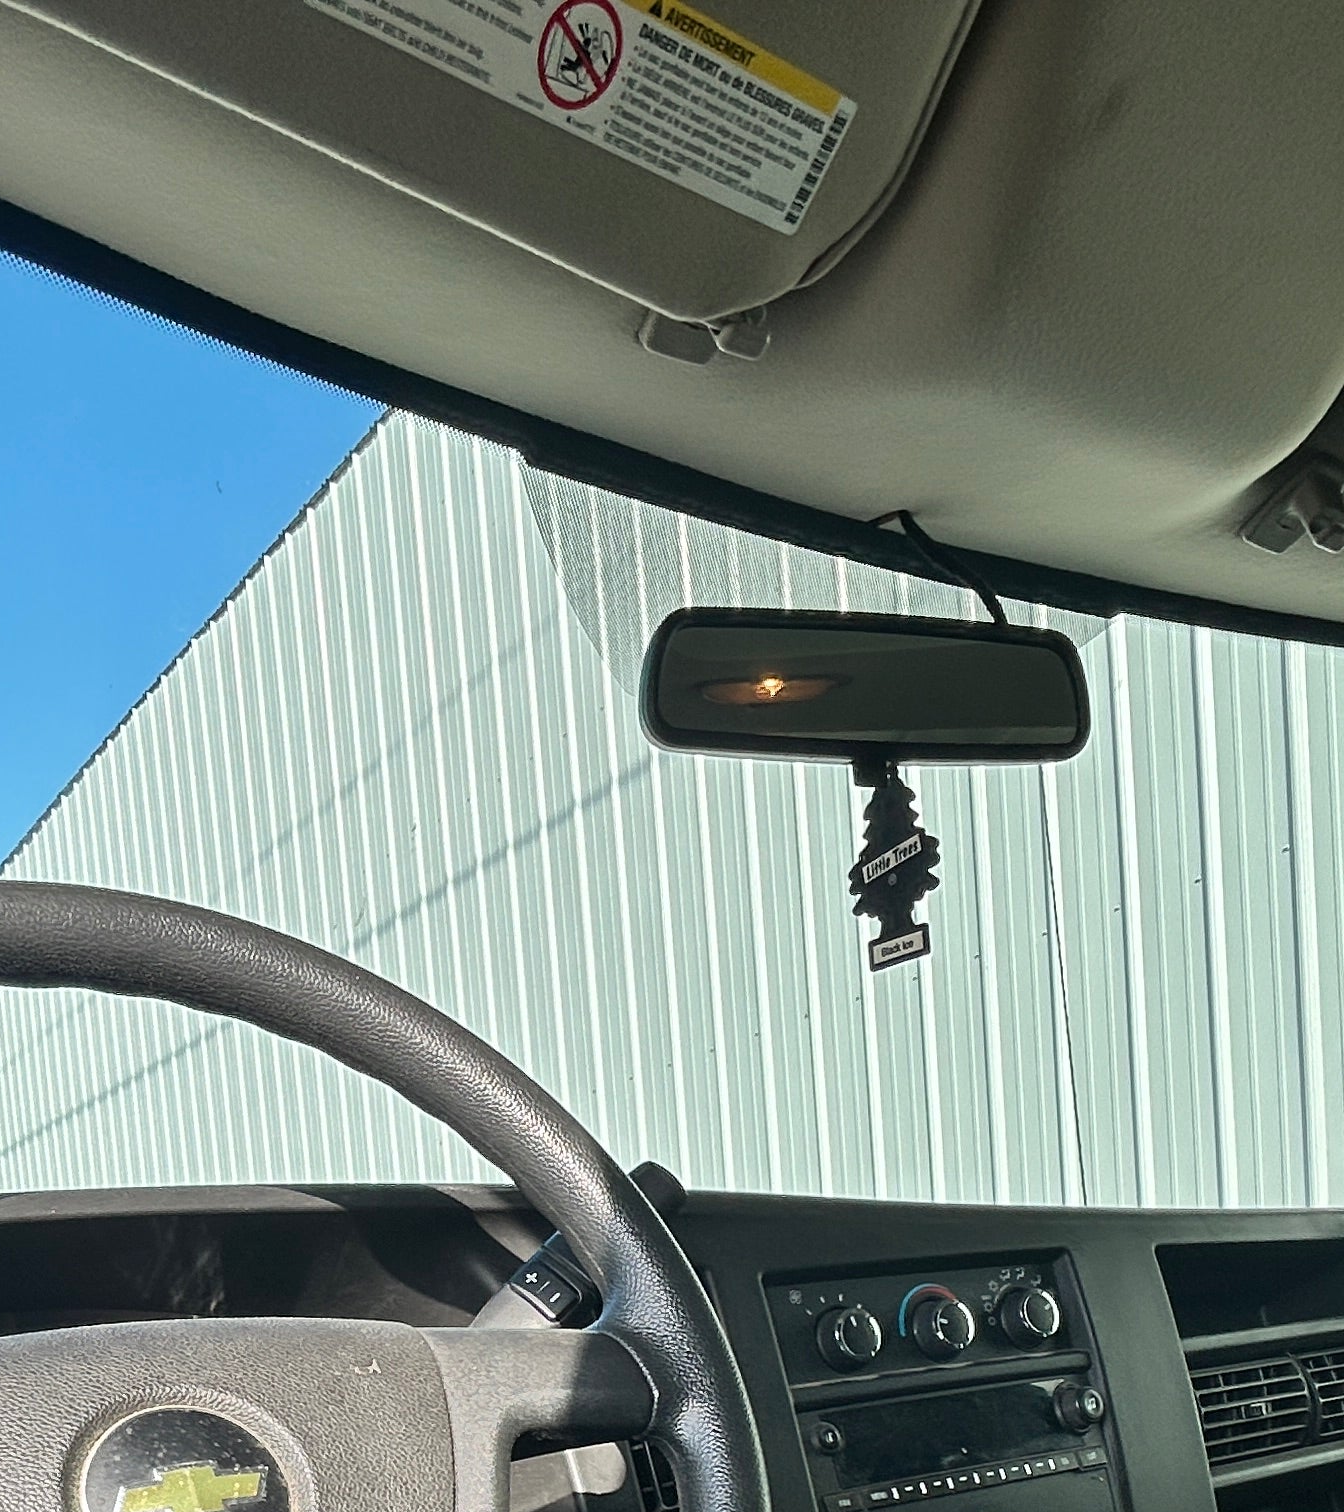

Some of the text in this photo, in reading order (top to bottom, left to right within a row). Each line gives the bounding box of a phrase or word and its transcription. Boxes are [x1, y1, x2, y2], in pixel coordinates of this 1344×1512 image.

[665, 7, 755, 66] AVERTISSEMENT
[866, 840, 918, 880] Little Trees
